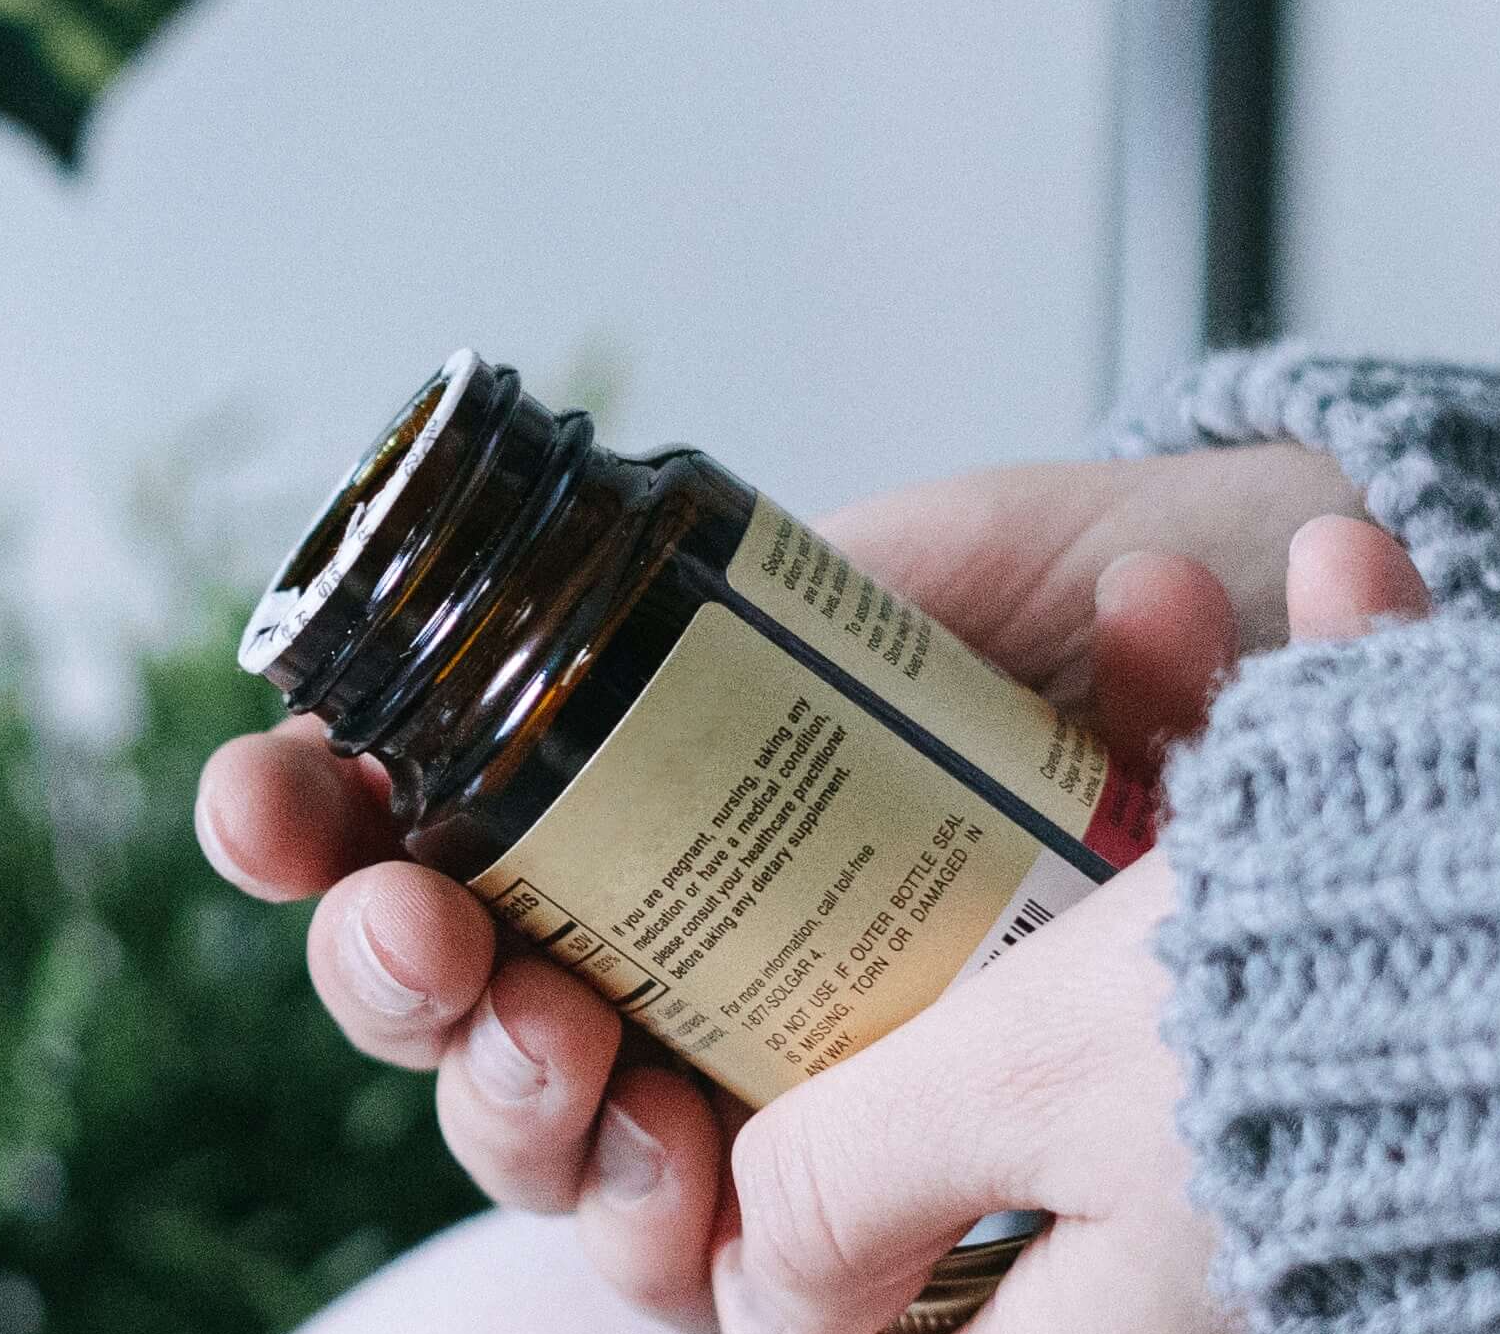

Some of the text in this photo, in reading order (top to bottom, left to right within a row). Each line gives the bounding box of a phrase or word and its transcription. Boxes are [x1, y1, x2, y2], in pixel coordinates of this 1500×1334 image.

[844, 622, 863, 638] To
[882, 642, 906, 667] Store
[902, 656, 927, 681] Keep
[612, 696, 811, 936] If you are pregnant, nursing, taking any
[633, 714, 832, 950] medication or have a medical condition,
[652, 724, 848, 967] please consult your healthcare practitioner
[669, 766, 851, 979] before taking any dietary supplement.
[500, 892, 540, 921] acts
[720, 844, 875, 1016] For more information, call toll-free
[742, 948, 826, 1030] 1-877-SOLGAR 4.
[766, 813, 965, 1050] DO NOT USE IF OUTER BOTTLE SEAL
[785, 824, 984, 1065] IS MISSING, TORN OR DAMAGED IN
[806, 1033, 857, 1076] ANY WAY.
